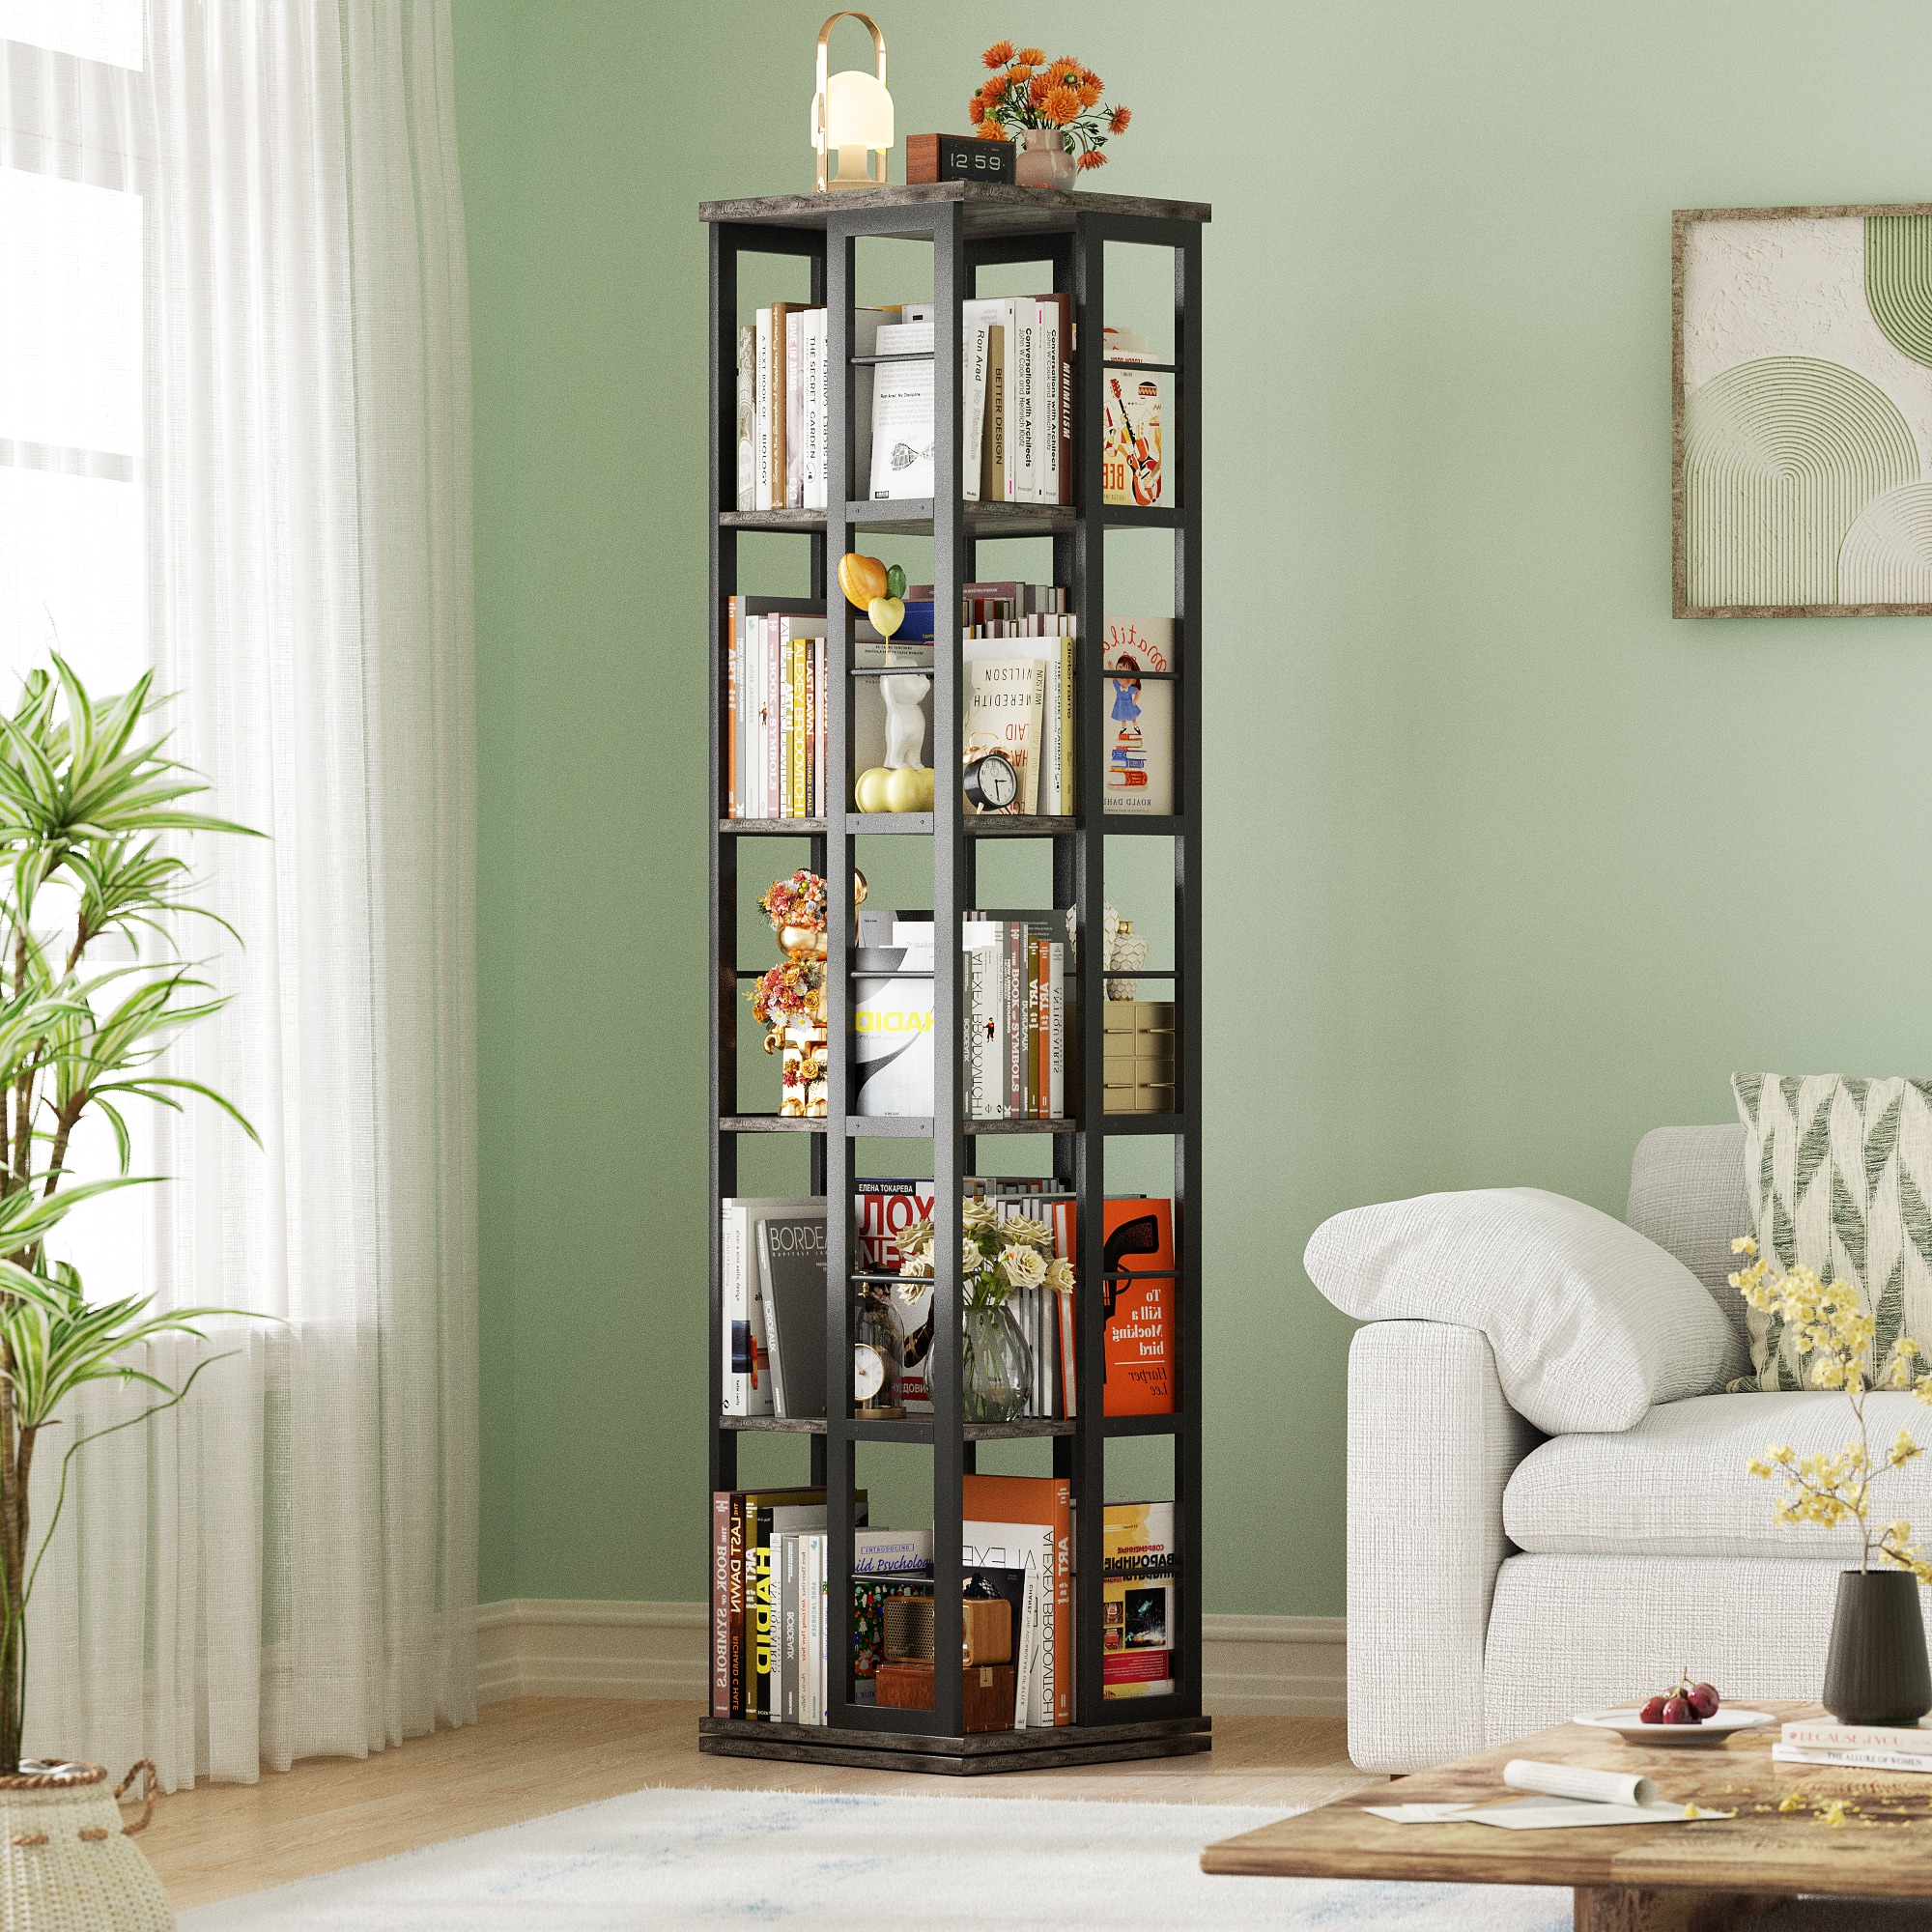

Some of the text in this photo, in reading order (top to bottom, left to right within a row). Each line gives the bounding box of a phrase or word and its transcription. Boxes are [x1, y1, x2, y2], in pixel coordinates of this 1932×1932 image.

[952, 153, 1001, 170] 12 59
[789, 317, 798, 346] LOVE
[975, 329, 985, 381] Ron Arad
[789, 360, 798, 391] ARMS
[1063, 361, 1071, 440] MINIMALISM
[769, 661, 778, 703] BOOK
[1035, 669, 1044, 705] WILLSON
[795, 642, 805, 808] ALEXEY BRODOVITCH
[769, 718, 778, 791] SYMBOLS
[1011, 969, 1020, 1008] BOOK
[1011, 1023, 1020, 1092] SYMBOLS
[858, 1183, 914, 1193] ЕЛЕНА ТОКАРЕВА
[770, 1227, 828, 1251] BORDE
[765, 1300, 777, 1352] BORDEAUX
[866, 1545, 910, 1553] INTRODUCING
[1846, 1754, 1875, 1763] ALLURE
[1890, 1757, 1922, 1766] WOMEN
